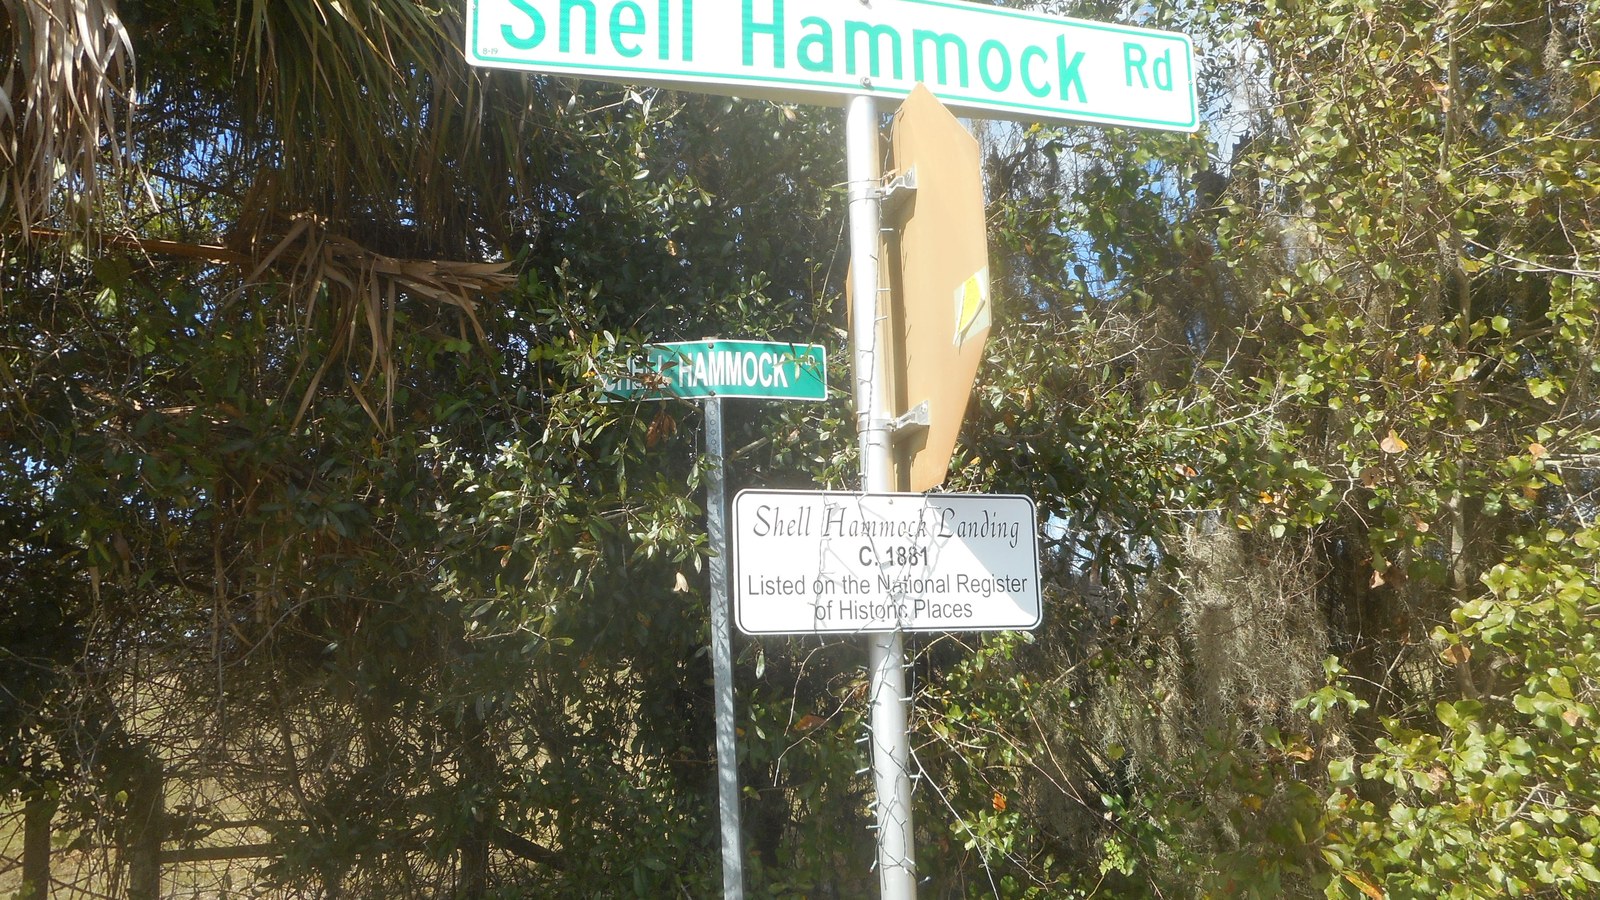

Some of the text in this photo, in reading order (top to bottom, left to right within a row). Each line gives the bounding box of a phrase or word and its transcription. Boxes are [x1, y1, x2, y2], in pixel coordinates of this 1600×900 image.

[500, 0, 1174, 103] Shell Hammock Rd
[678, 351, 789, 388] HAMMOCK
[753, 505, 1019, 549] Shell Hammock Landing
[859, 546, 928, 567] C. 1881
[748, 574, 1028, 598] Listed on the National Register
[815, 599, 973, 621] of Historic Places
